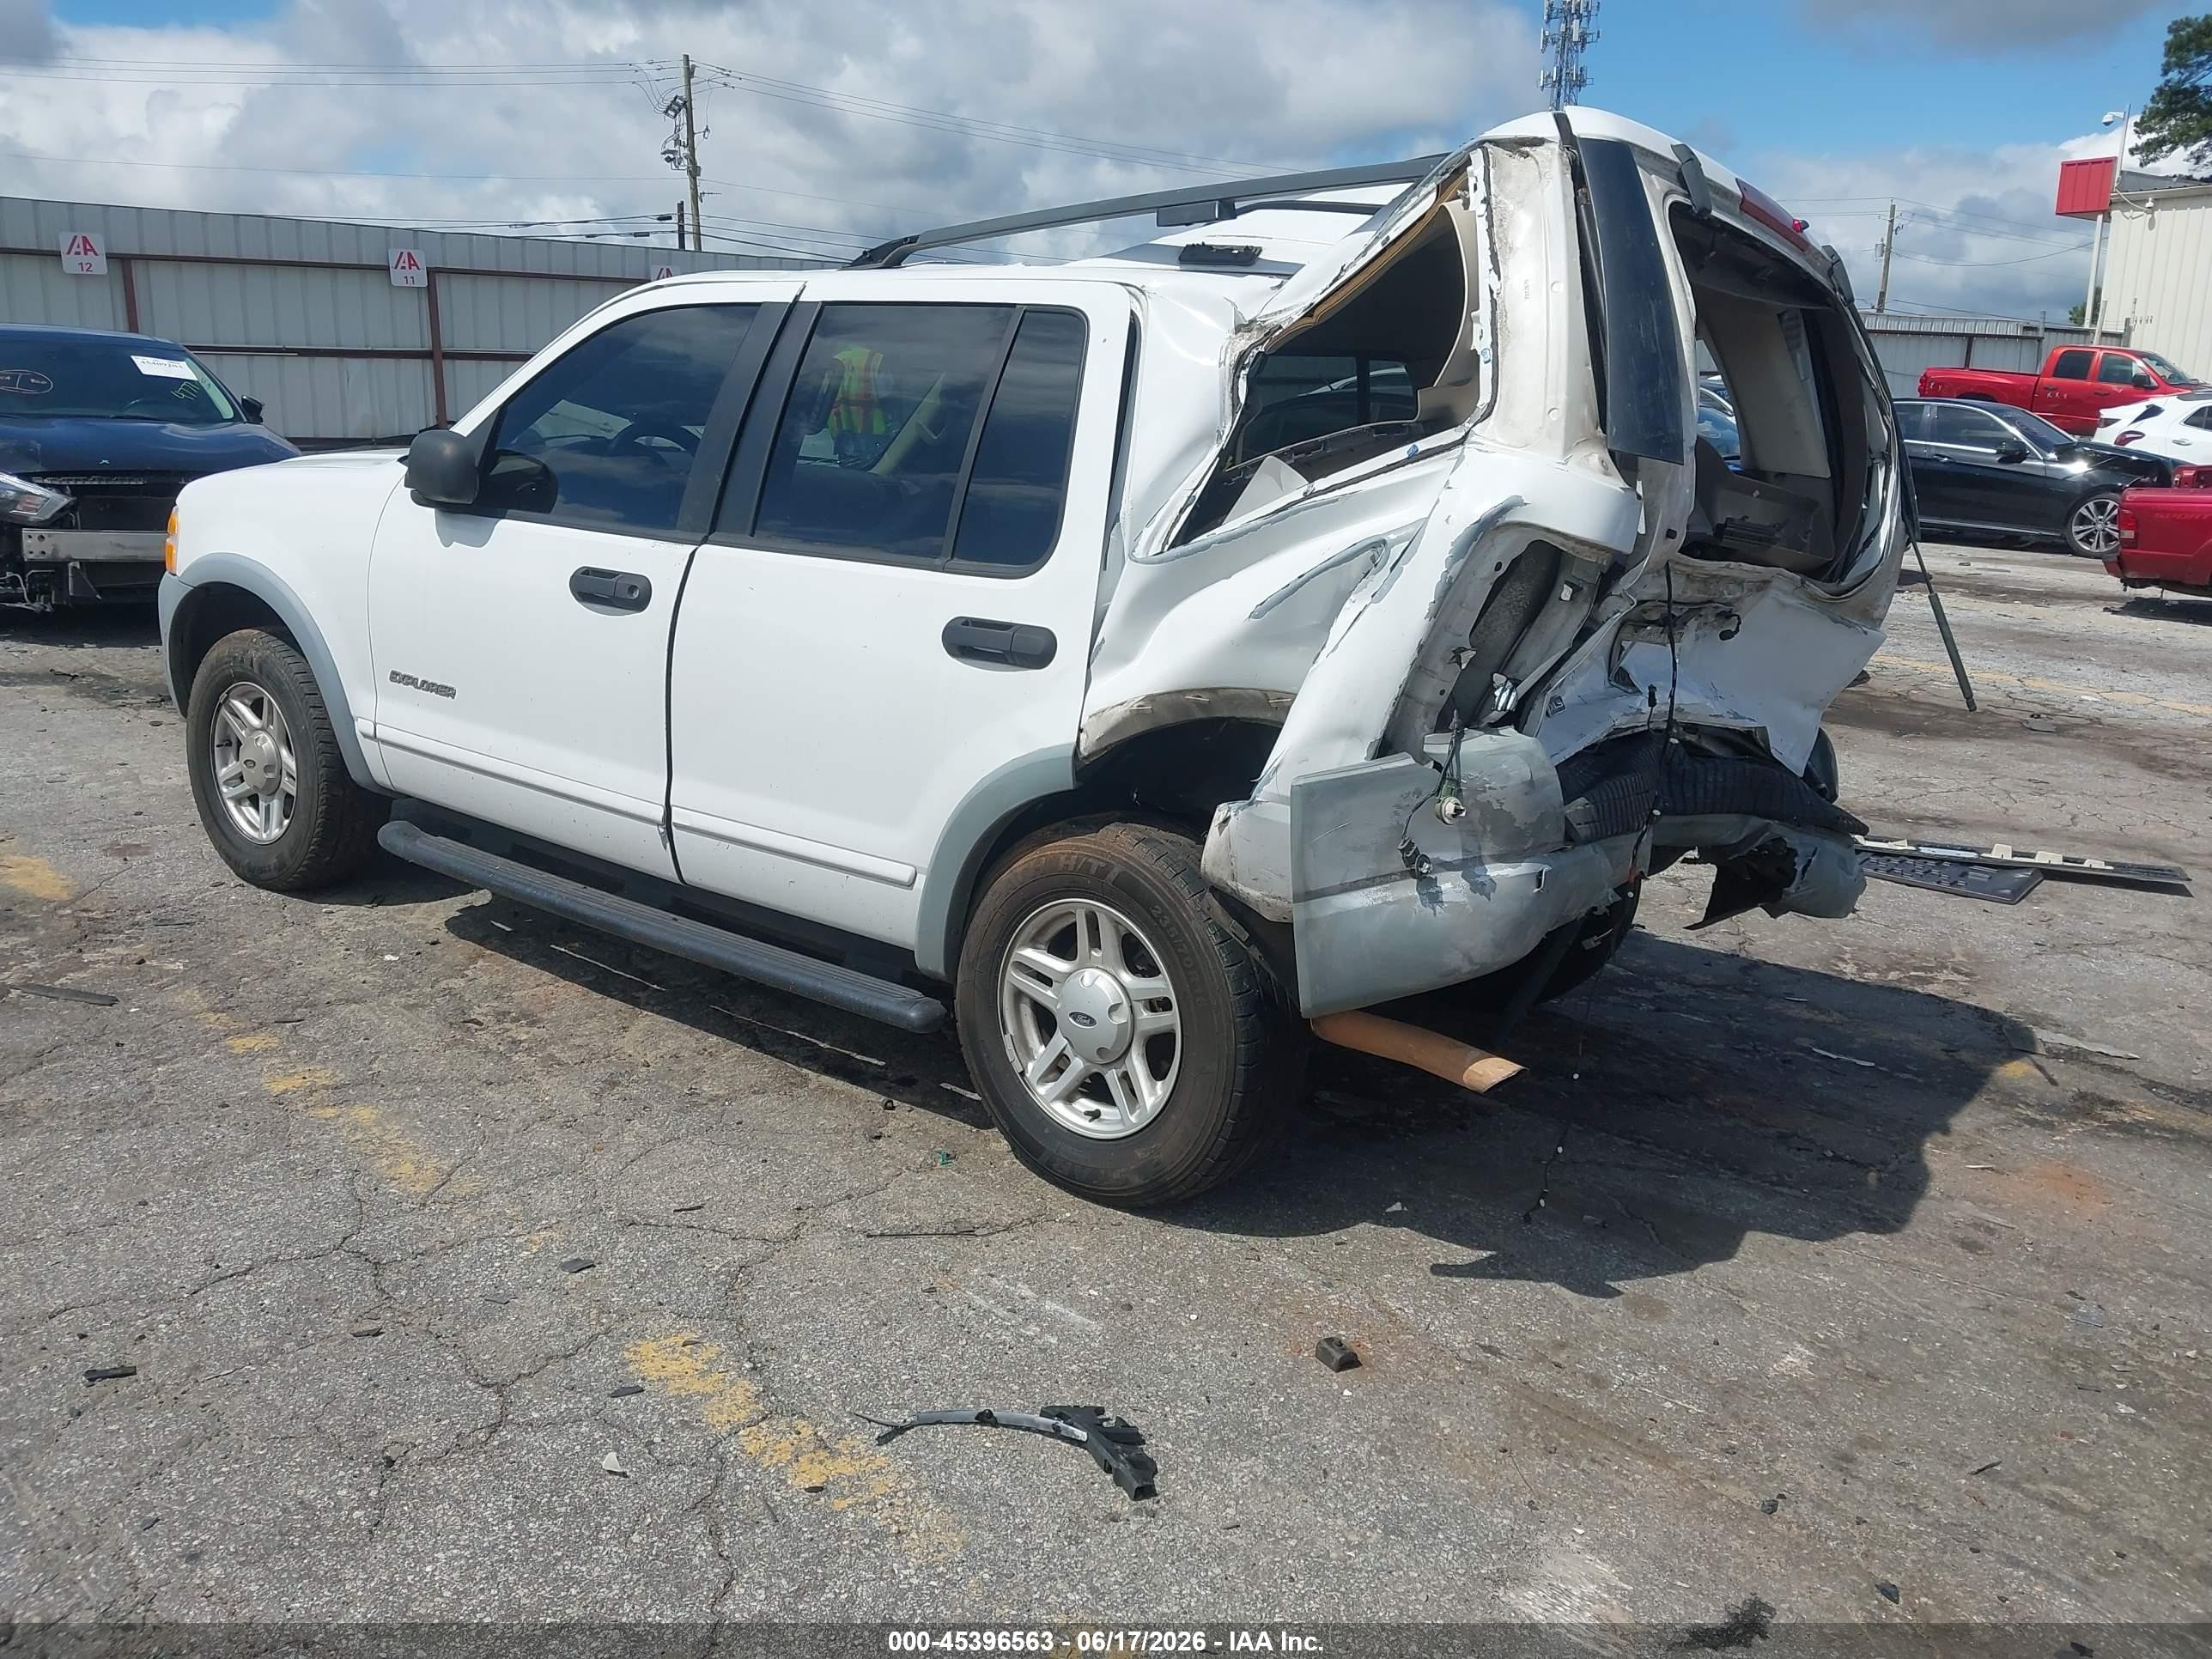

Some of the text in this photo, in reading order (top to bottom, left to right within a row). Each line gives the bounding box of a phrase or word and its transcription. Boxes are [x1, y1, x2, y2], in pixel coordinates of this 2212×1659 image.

[78, 262, 94, 272] 12
[404, 276, 415, 285] 11
[389, 670, 456, 700] EXPLORER
